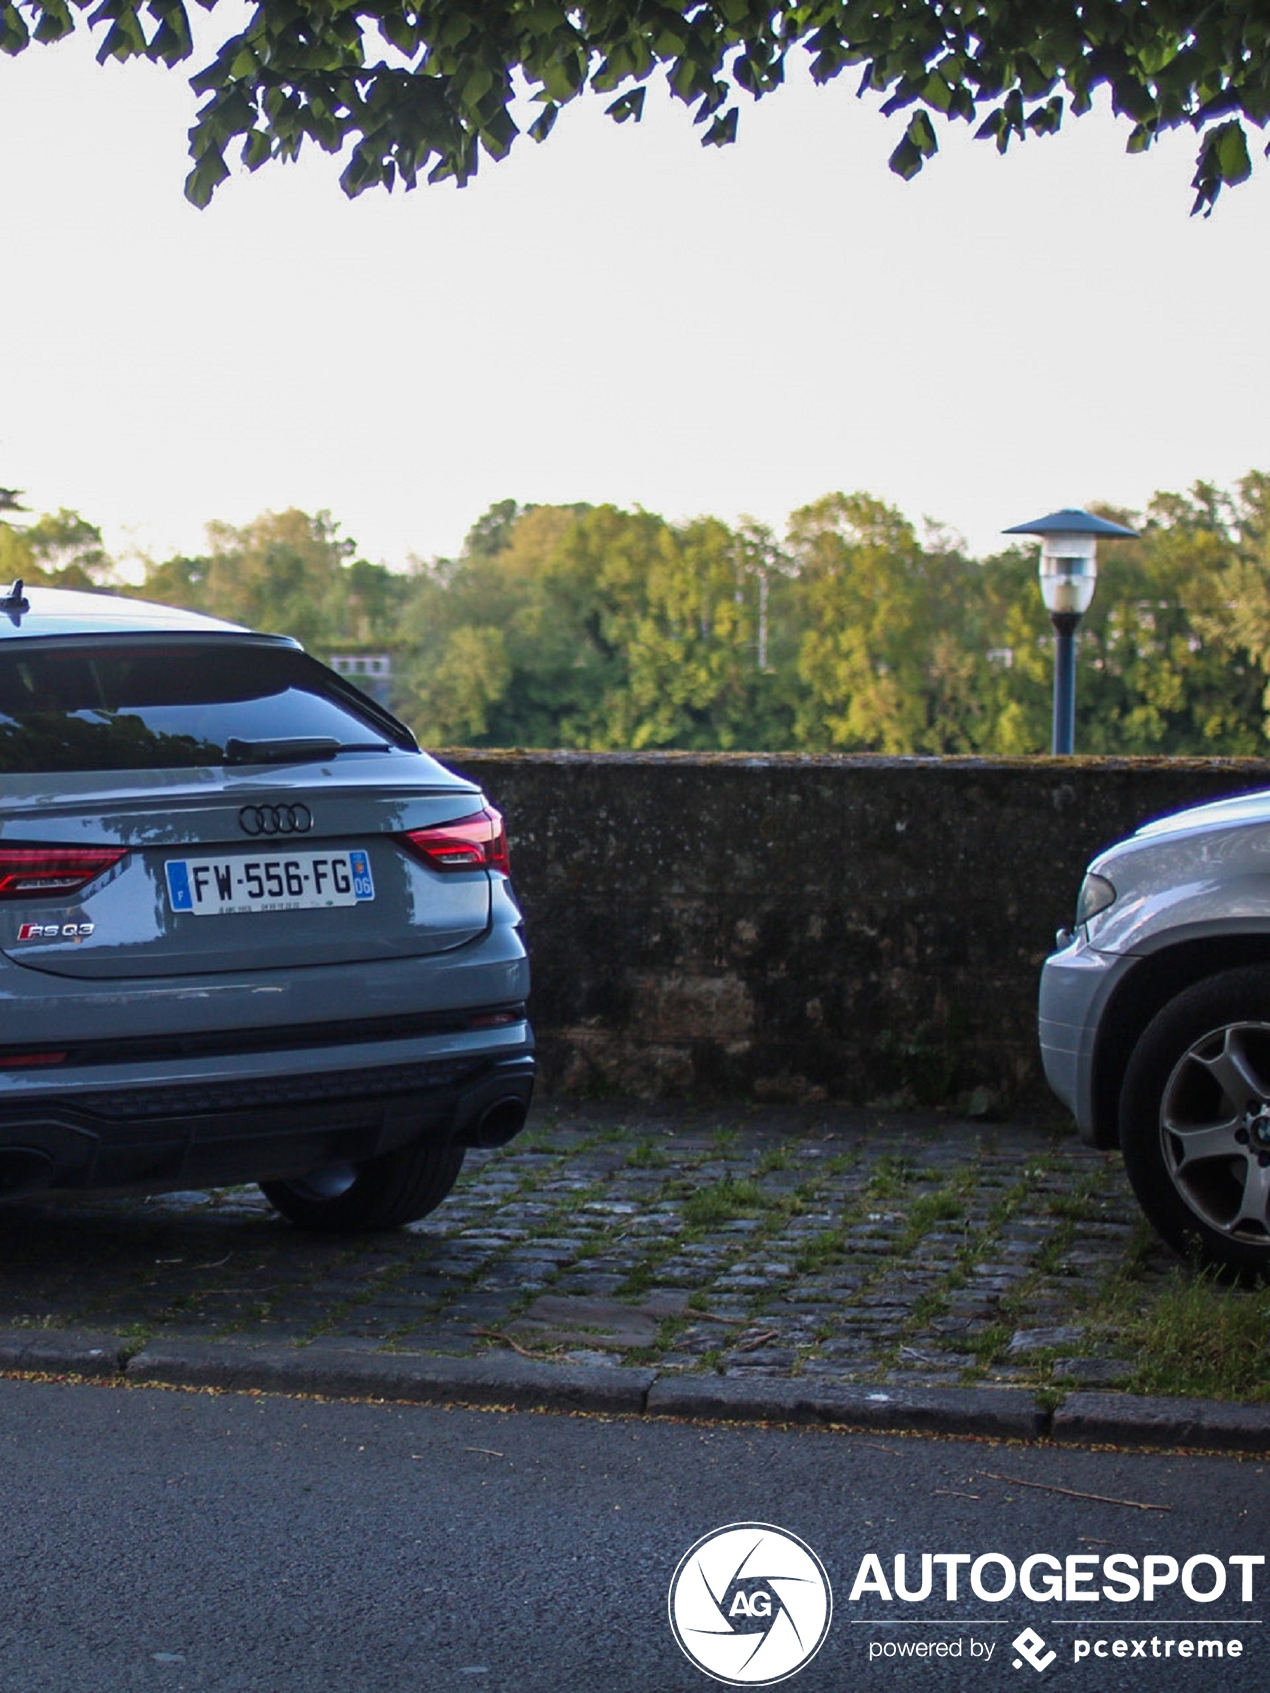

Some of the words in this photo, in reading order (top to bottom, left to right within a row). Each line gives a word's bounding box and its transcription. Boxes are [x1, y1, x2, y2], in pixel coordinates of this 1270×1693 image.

[192, 858, 351, 902] FW-556-FG
[354, 876, 371, 894] 06
[177, 890, 184, 902] F
[20, 923, 59, 939] RS
[62, 923, 95, 936] Q3
